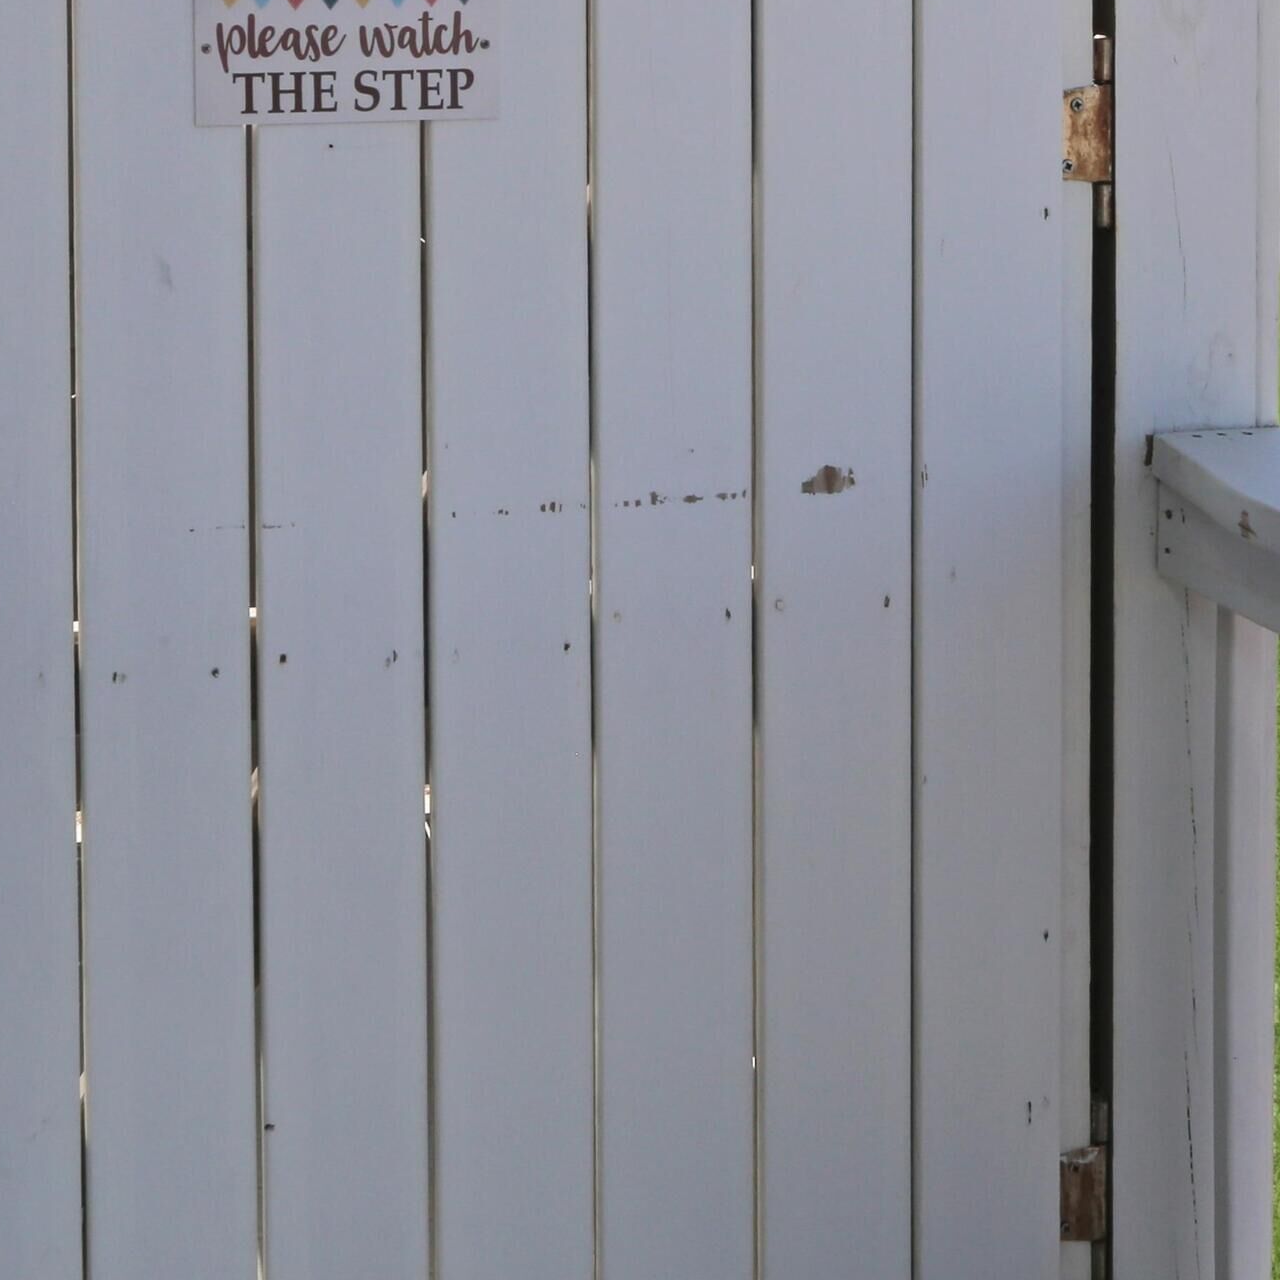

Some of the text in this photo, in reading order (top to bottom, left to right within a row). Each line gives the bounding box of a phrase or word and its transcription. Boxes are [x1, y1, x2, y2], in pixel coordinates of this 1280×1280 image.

[216, 11, 479, 73] please watch
[232, 68, 475, 115] THE STEP
